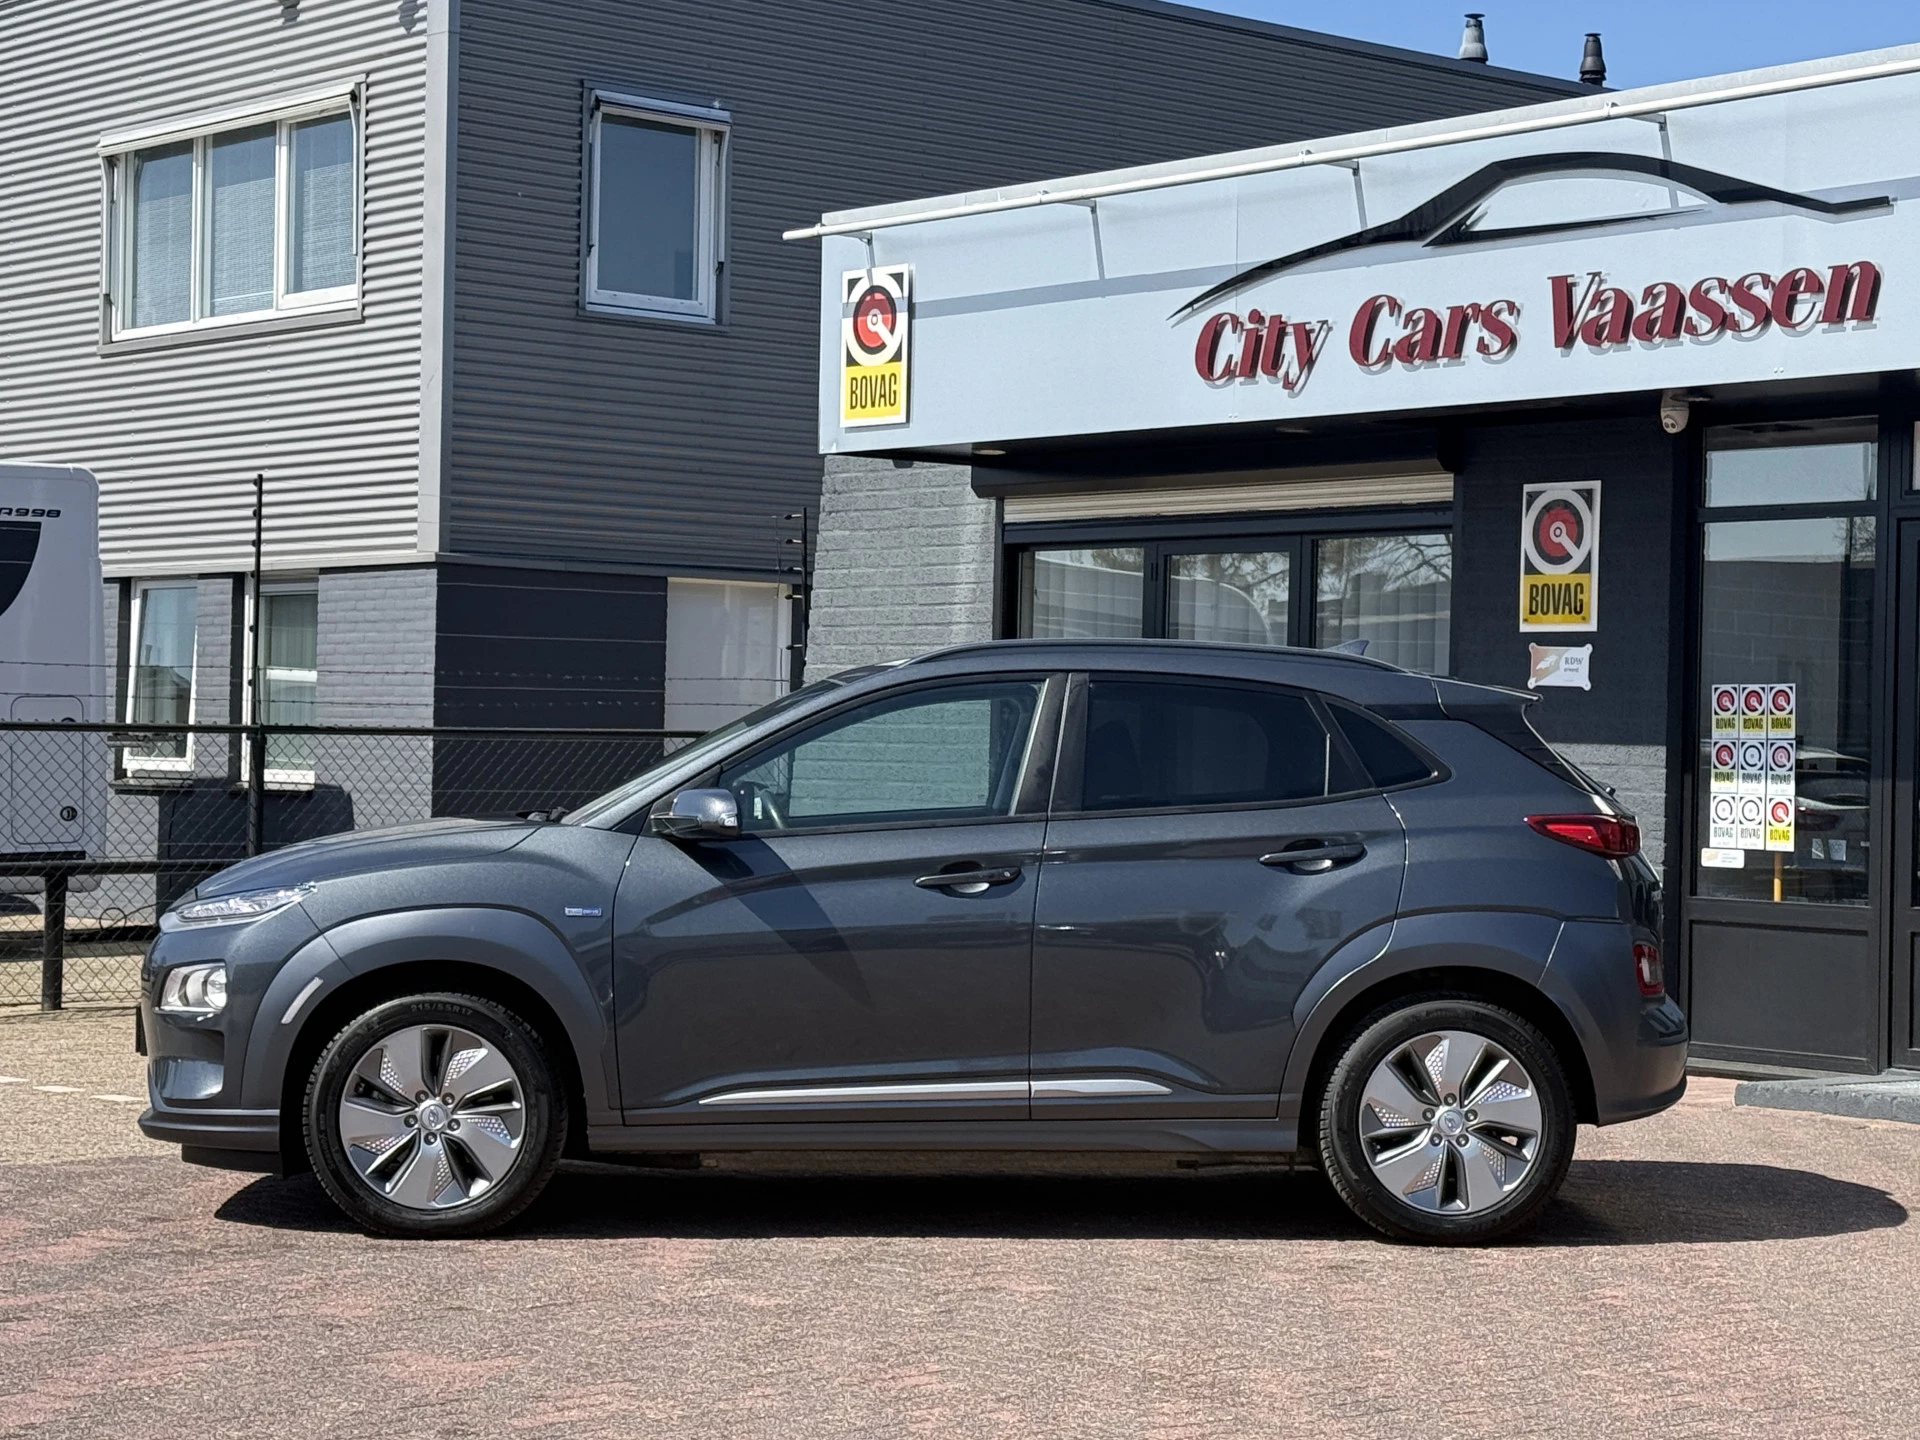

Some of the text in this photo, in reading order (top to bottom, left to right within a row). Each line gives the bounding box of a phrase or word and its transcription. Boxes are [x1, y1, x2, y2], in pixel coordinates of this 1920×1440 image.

[1194, 260, 1882, 392] City Cars Vaassen
[849, 372, 897, 410] BOVAG
[1528, 582, 1585, 616] BOVAG
[1564, 656, 1584, 666] RDW
[1715, 717, 1736, 730] BOVAG
[1742, 717, 1764, 730] BOVAG
[1771, 716, 1792, 730] BOVAG
[1714, 771, 1735, 783] BOVAG
[1741, 772, 1763, 785] BOVAG
[1770, 773, 1792, 785] BOVAG
[1713, 826, 1734, 838] BOVAG
[1740, 827, 1761, 840] BOVAG
[1769, 828, 1790, 841] BOVAG
